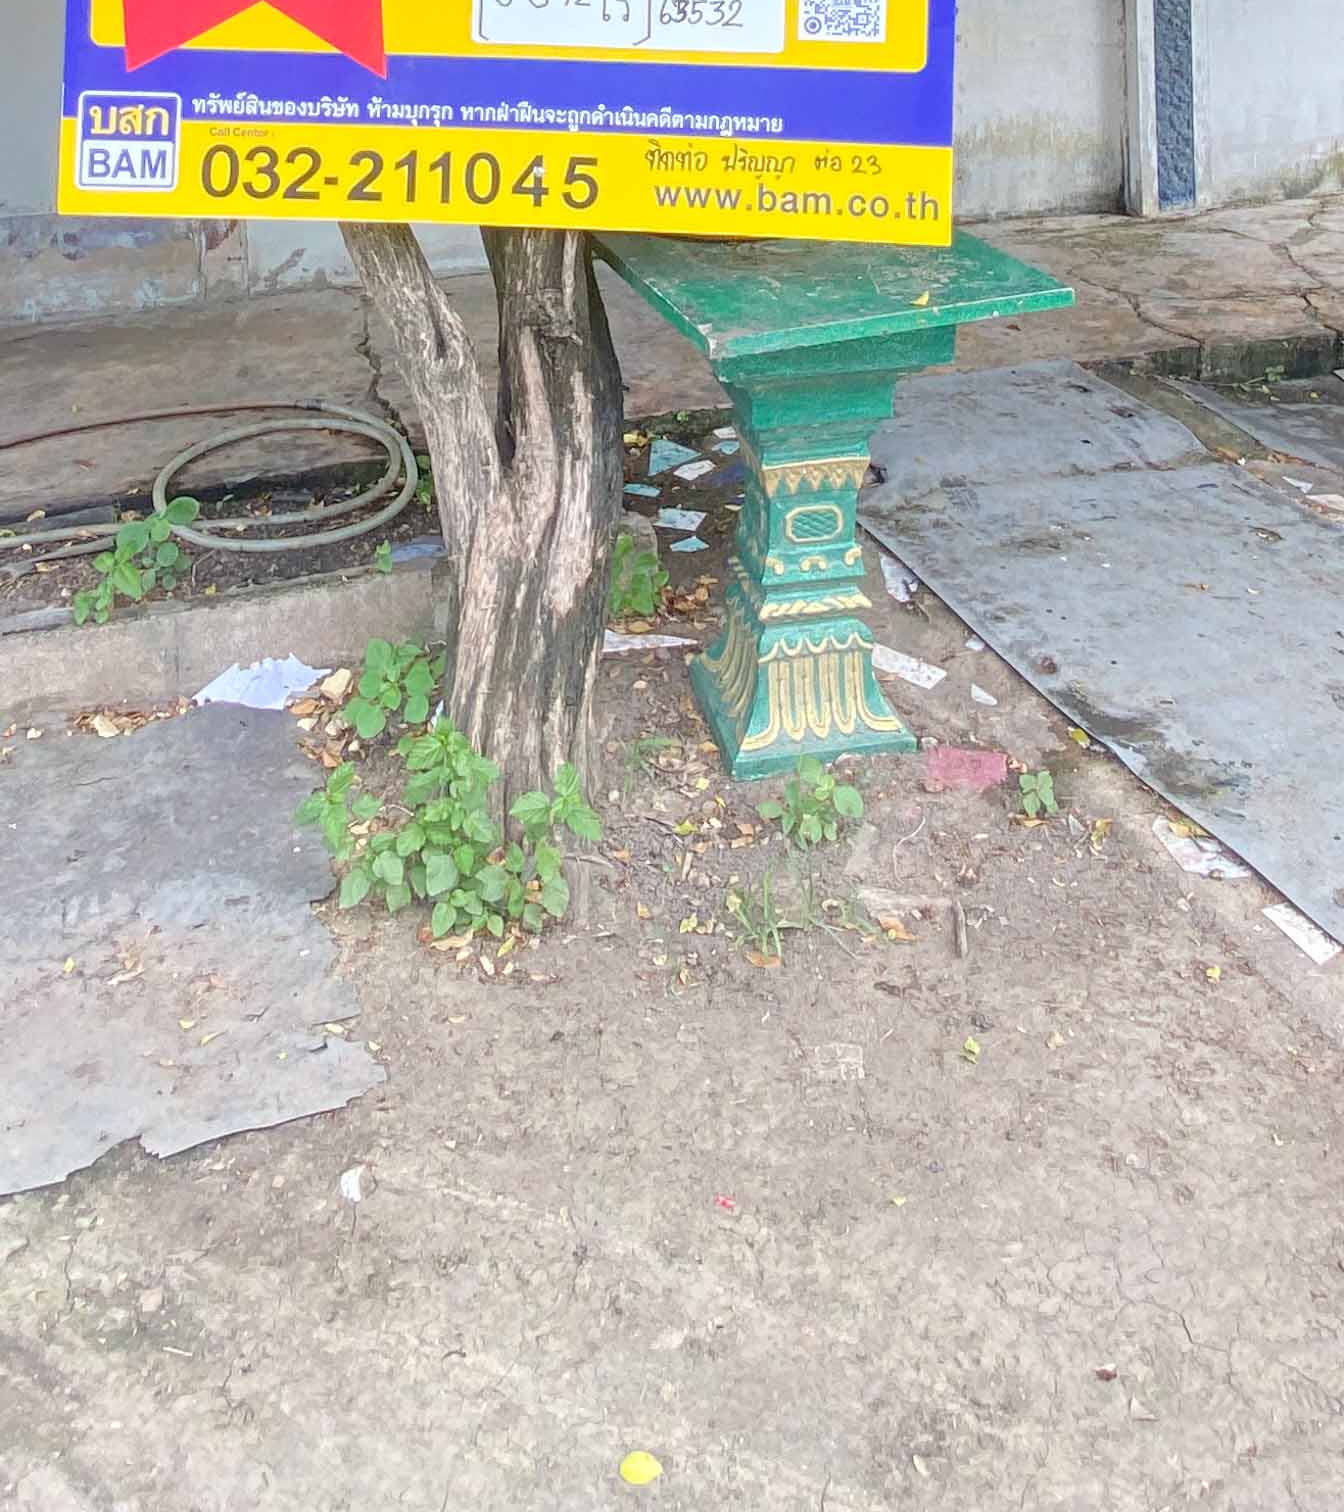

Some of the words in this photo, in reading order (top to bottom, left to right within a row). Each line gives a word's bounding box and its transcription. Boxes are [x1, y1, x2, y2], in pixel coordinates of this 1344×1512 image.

[89, 103, 170, 137] บสก
[191, 91, 360, 118] ทรัพย์สินของบริษัท
[366, 96, 454, 128] ห้ามบุกรุก
[209, 127, 231, 137] Call
[87, 147, 168, 179] BAM
[201, 143, 600, 210] 032-211045
[851, 155, 883, 175] 23
[654, 182, 941, 222] www.bam.co.th
